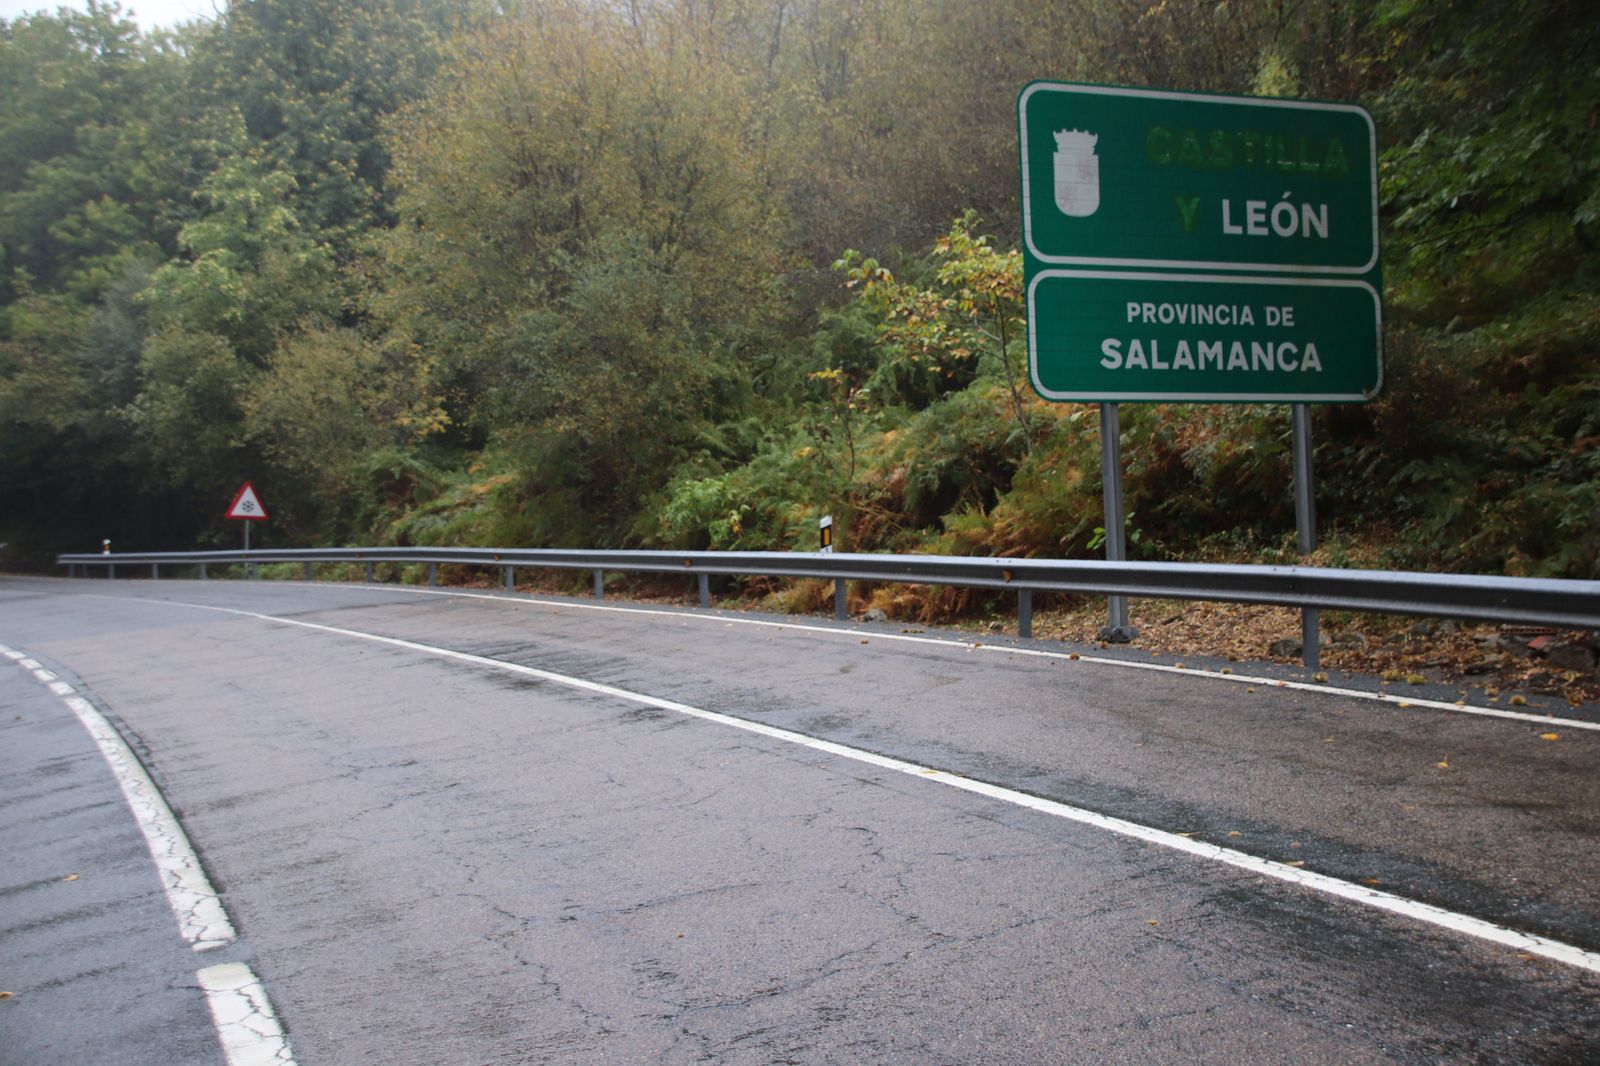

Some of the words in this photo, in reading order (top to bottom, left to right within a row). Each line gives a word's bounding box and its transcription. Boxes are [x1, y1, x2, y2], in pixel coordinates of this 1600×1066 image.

[1146, 125, 1350, 173] CASTILLA
[1176, 194, 1200, 232] Y
[1222, 191, 1328, 239] LEÓN
[1126, 302, 1254, 326] PROVINCIA
[1265, 306, 1295, 327] DE
[1100, 338, 1322, 372] SALAMANCA
